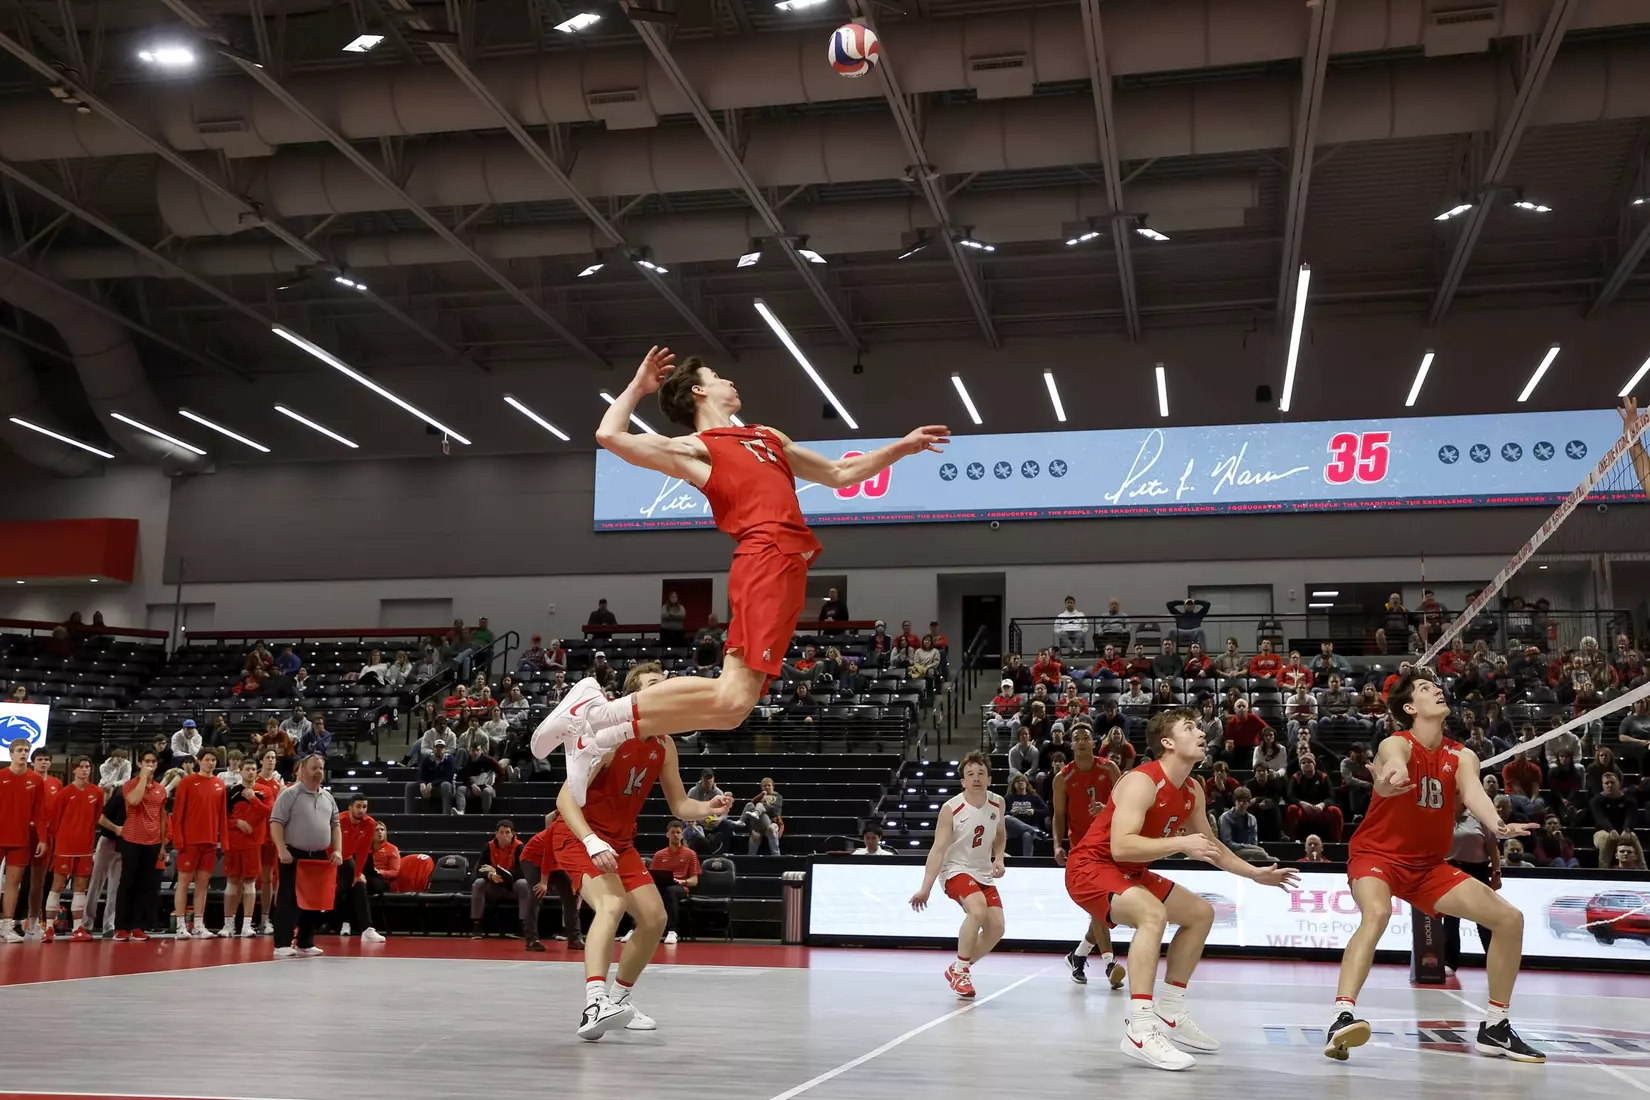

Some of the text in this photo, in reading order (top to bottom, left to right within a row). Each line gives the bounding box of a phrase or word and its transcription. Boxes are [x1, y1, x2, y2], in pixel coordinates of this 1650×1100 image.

[739, 438, 778, 464] 17
[1323, 430, 1392, 486] 35
[623, 765, 648, 796] 14
[1416, 775, 1445, 809] 18
[972, 824, 985, 849] 2
[1295, 920, 1328, 933] The
